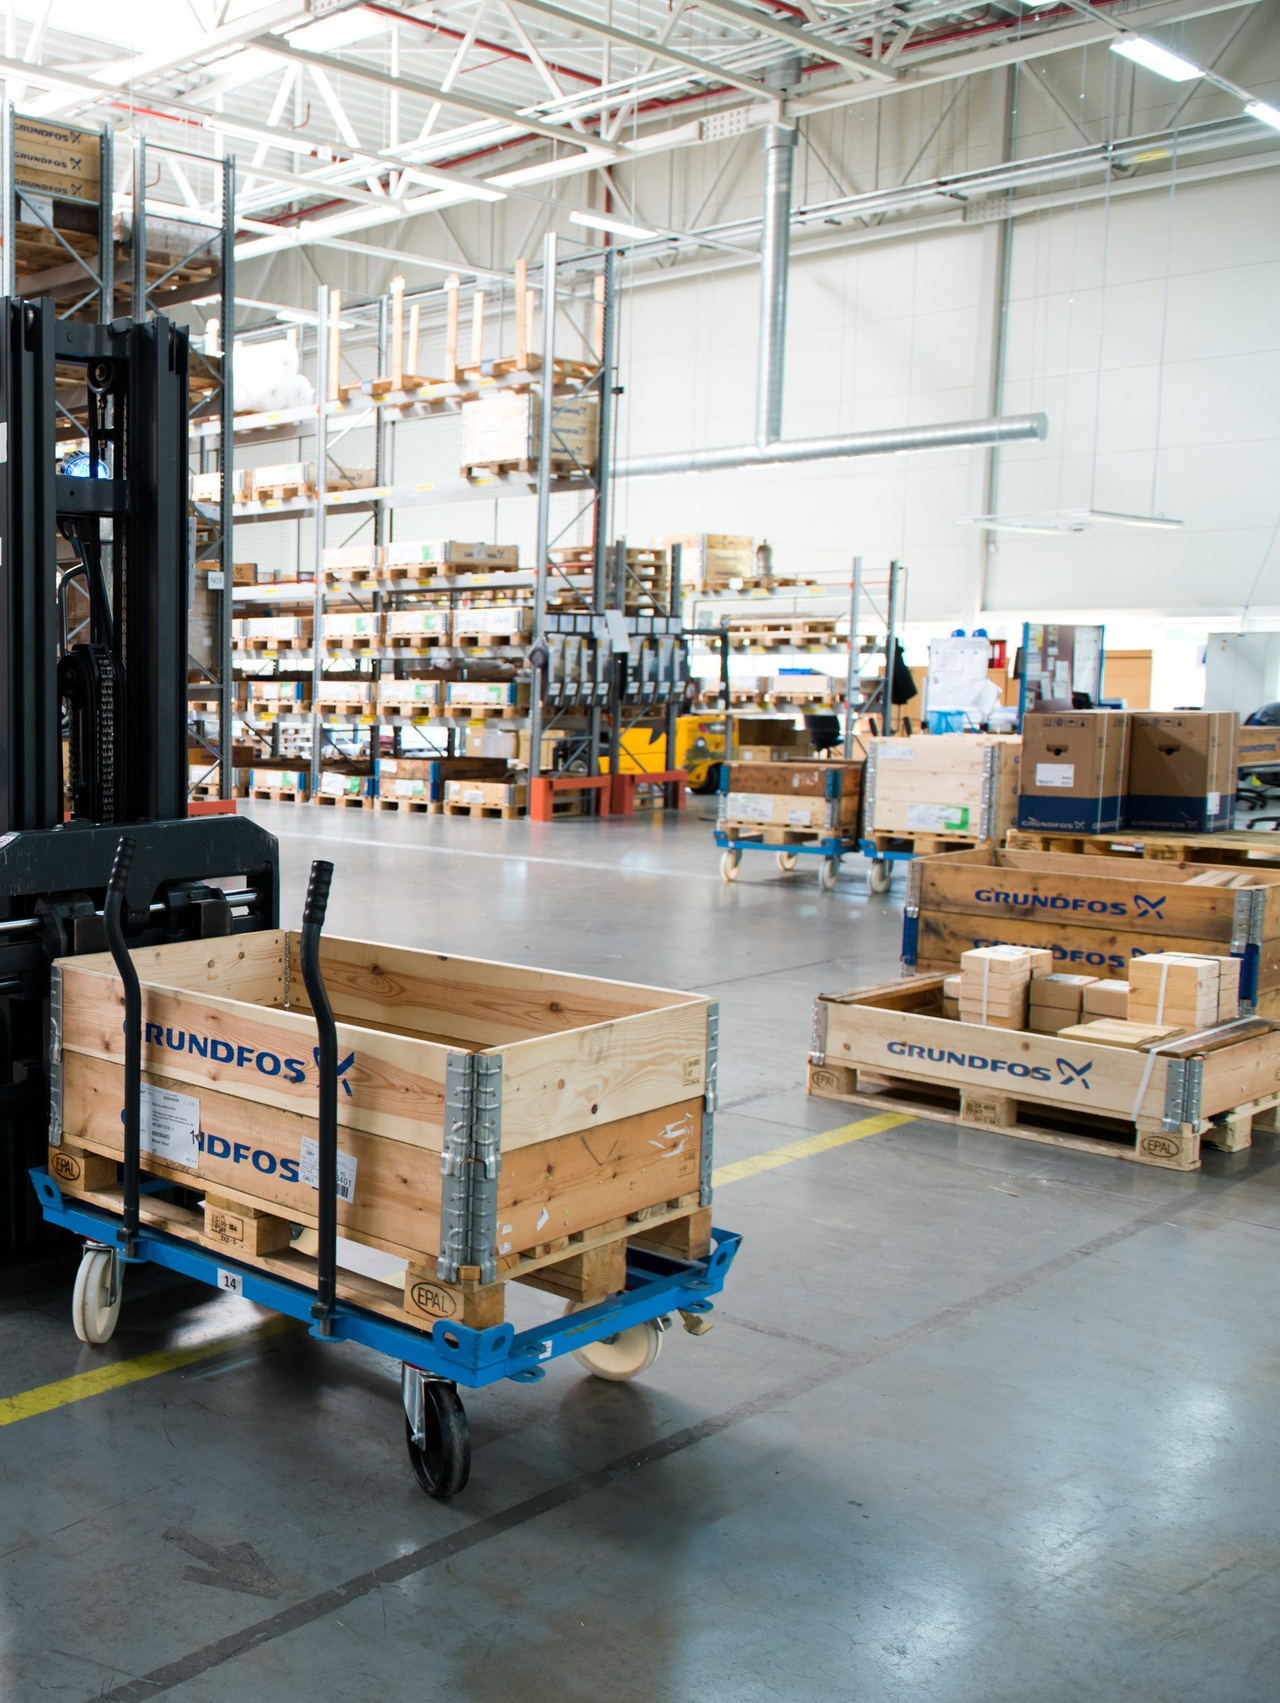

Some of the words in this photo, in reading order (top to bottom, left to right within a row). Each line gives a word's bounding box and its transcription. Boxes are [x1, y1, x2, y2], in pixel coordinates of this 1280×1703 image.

[974, 887, 1128, 918] GRUNDFOS
[122, 1017, 307, 1084] RUNDFOS
[886, 1039, 1053, 1084] GRUNDFOS
[198, 1130, 302, 1185] DFOS
[1146, 1138, 1173, 1155] EPAL
[55, 1156, 76, 1178] EPAL
[224, 1275, 237, 1290] 14
[417, 1286, 449, 1314] EPAL
